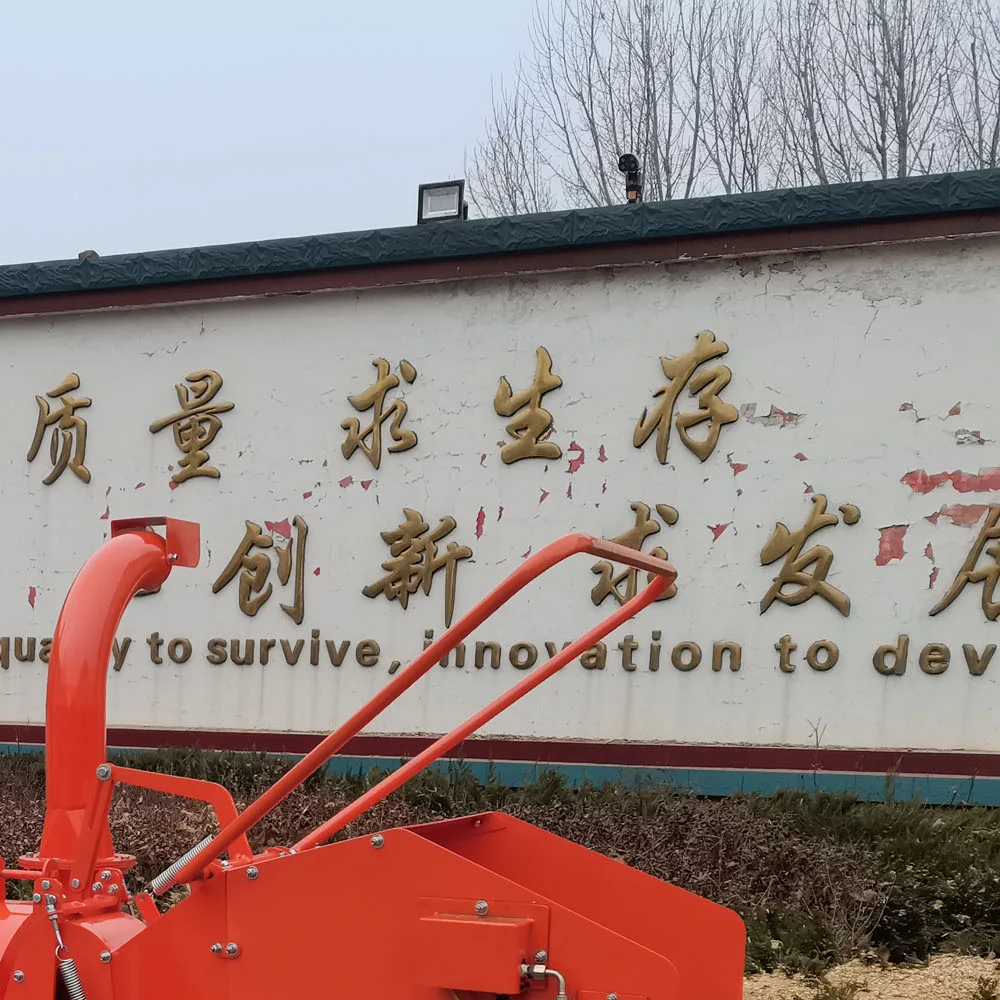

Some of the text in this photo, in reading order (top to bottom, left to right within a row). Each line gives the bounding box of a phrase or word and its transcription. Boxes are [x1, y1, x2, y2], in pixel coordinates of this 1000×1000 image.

[147, 631, 193, 664] to
[206, 628, 401, 675] survive,
[774, 634, 840, 673] to
[872, 634, 998, 676] dev
